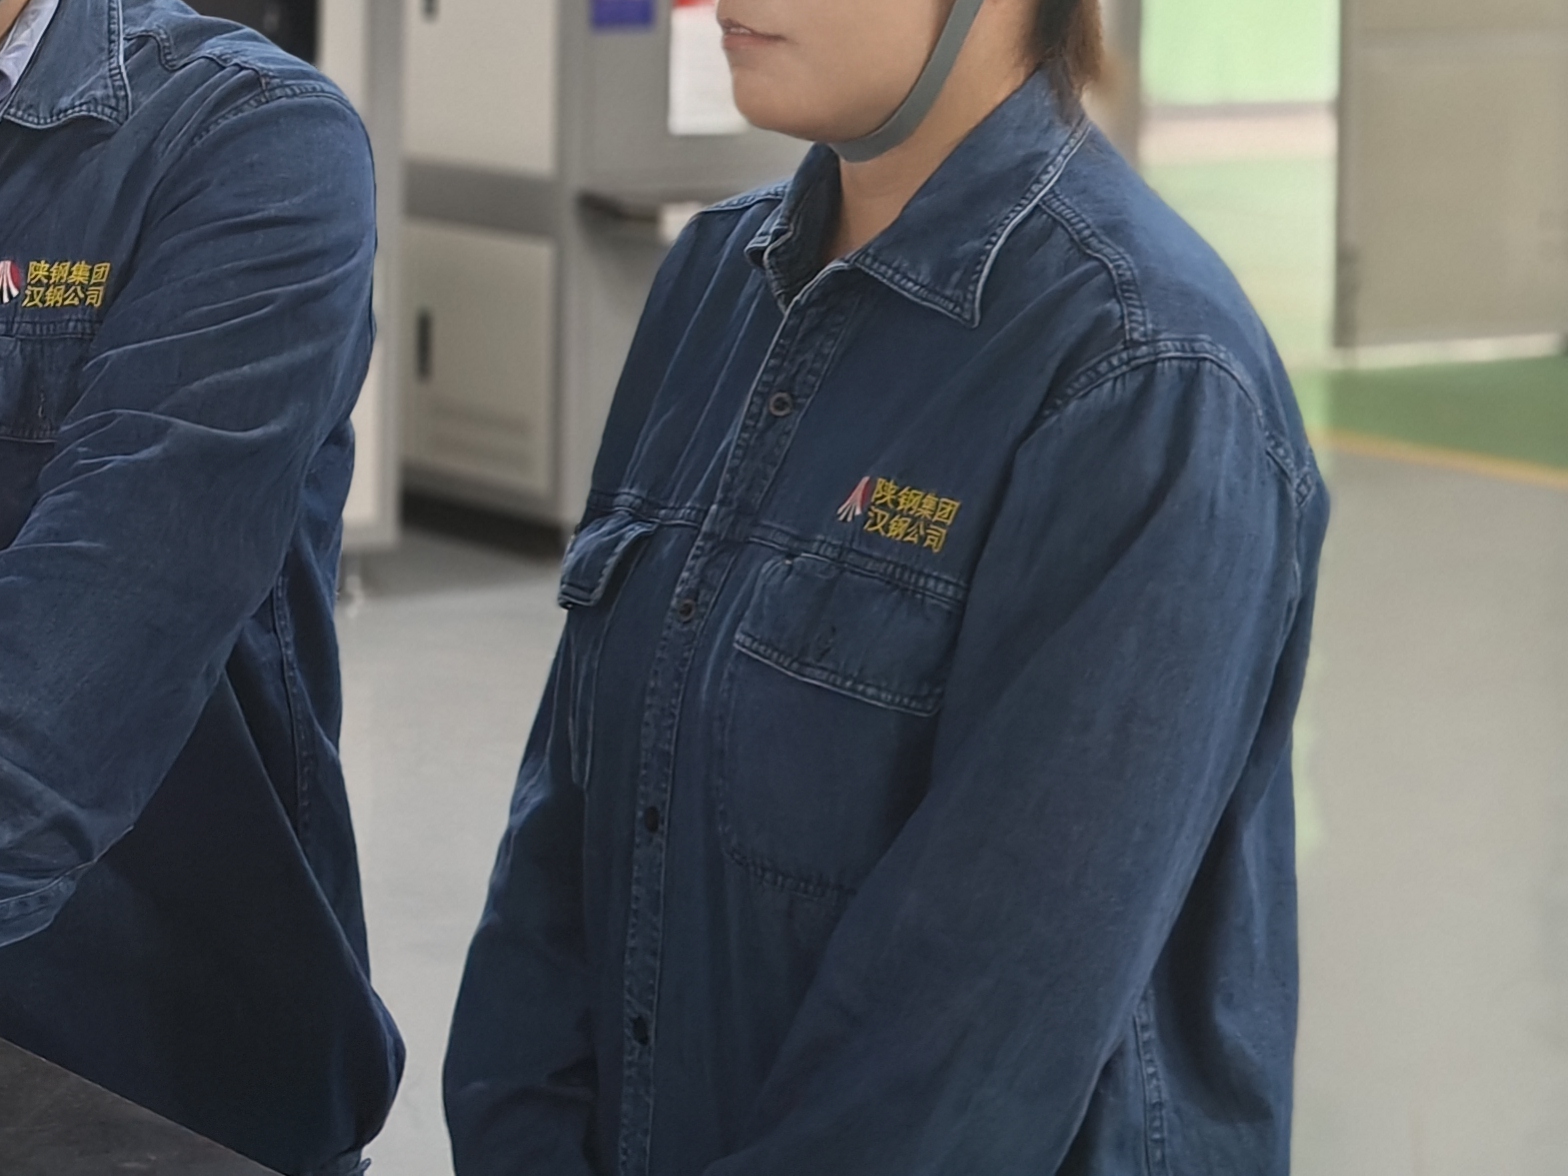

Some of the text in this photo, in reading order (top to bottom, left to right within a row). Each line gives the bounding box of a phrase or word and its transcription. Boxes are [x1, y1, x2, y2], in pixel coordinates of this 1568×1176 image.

[27, 260, 110, 284] 陕钢集团
[21, 286, 104, 307] 汉钢公司
[871, 477, 962, 525] 陕钢集团
[863, 506, 948, 554] 汉钢公司
